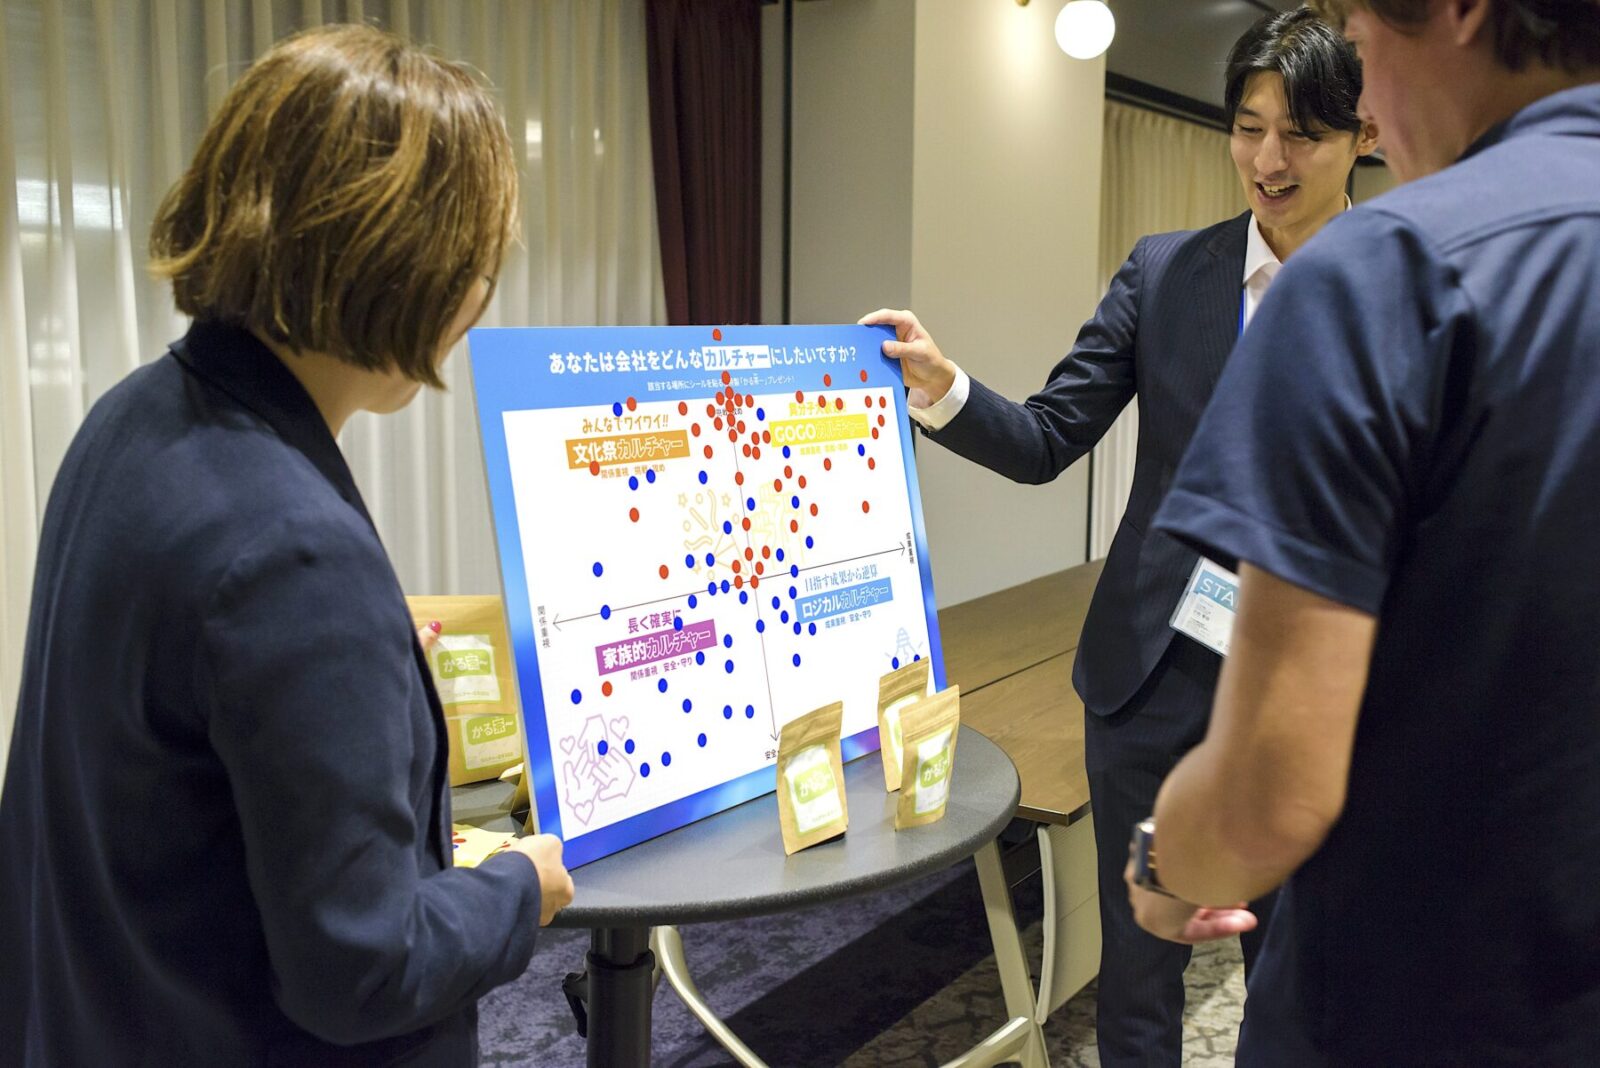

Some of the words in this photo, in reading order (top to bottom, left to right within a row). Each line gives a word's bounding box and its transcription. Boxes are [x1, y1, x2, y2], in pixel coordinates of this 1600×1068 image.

[573, 436, 684, 464] 文化祭カルチャー
[802, 586, 889, 618] ロジカルカルチャー
[1200, 578, 1235, 607] STA
[602, 630, 711, 670] 家族的カルチャー
